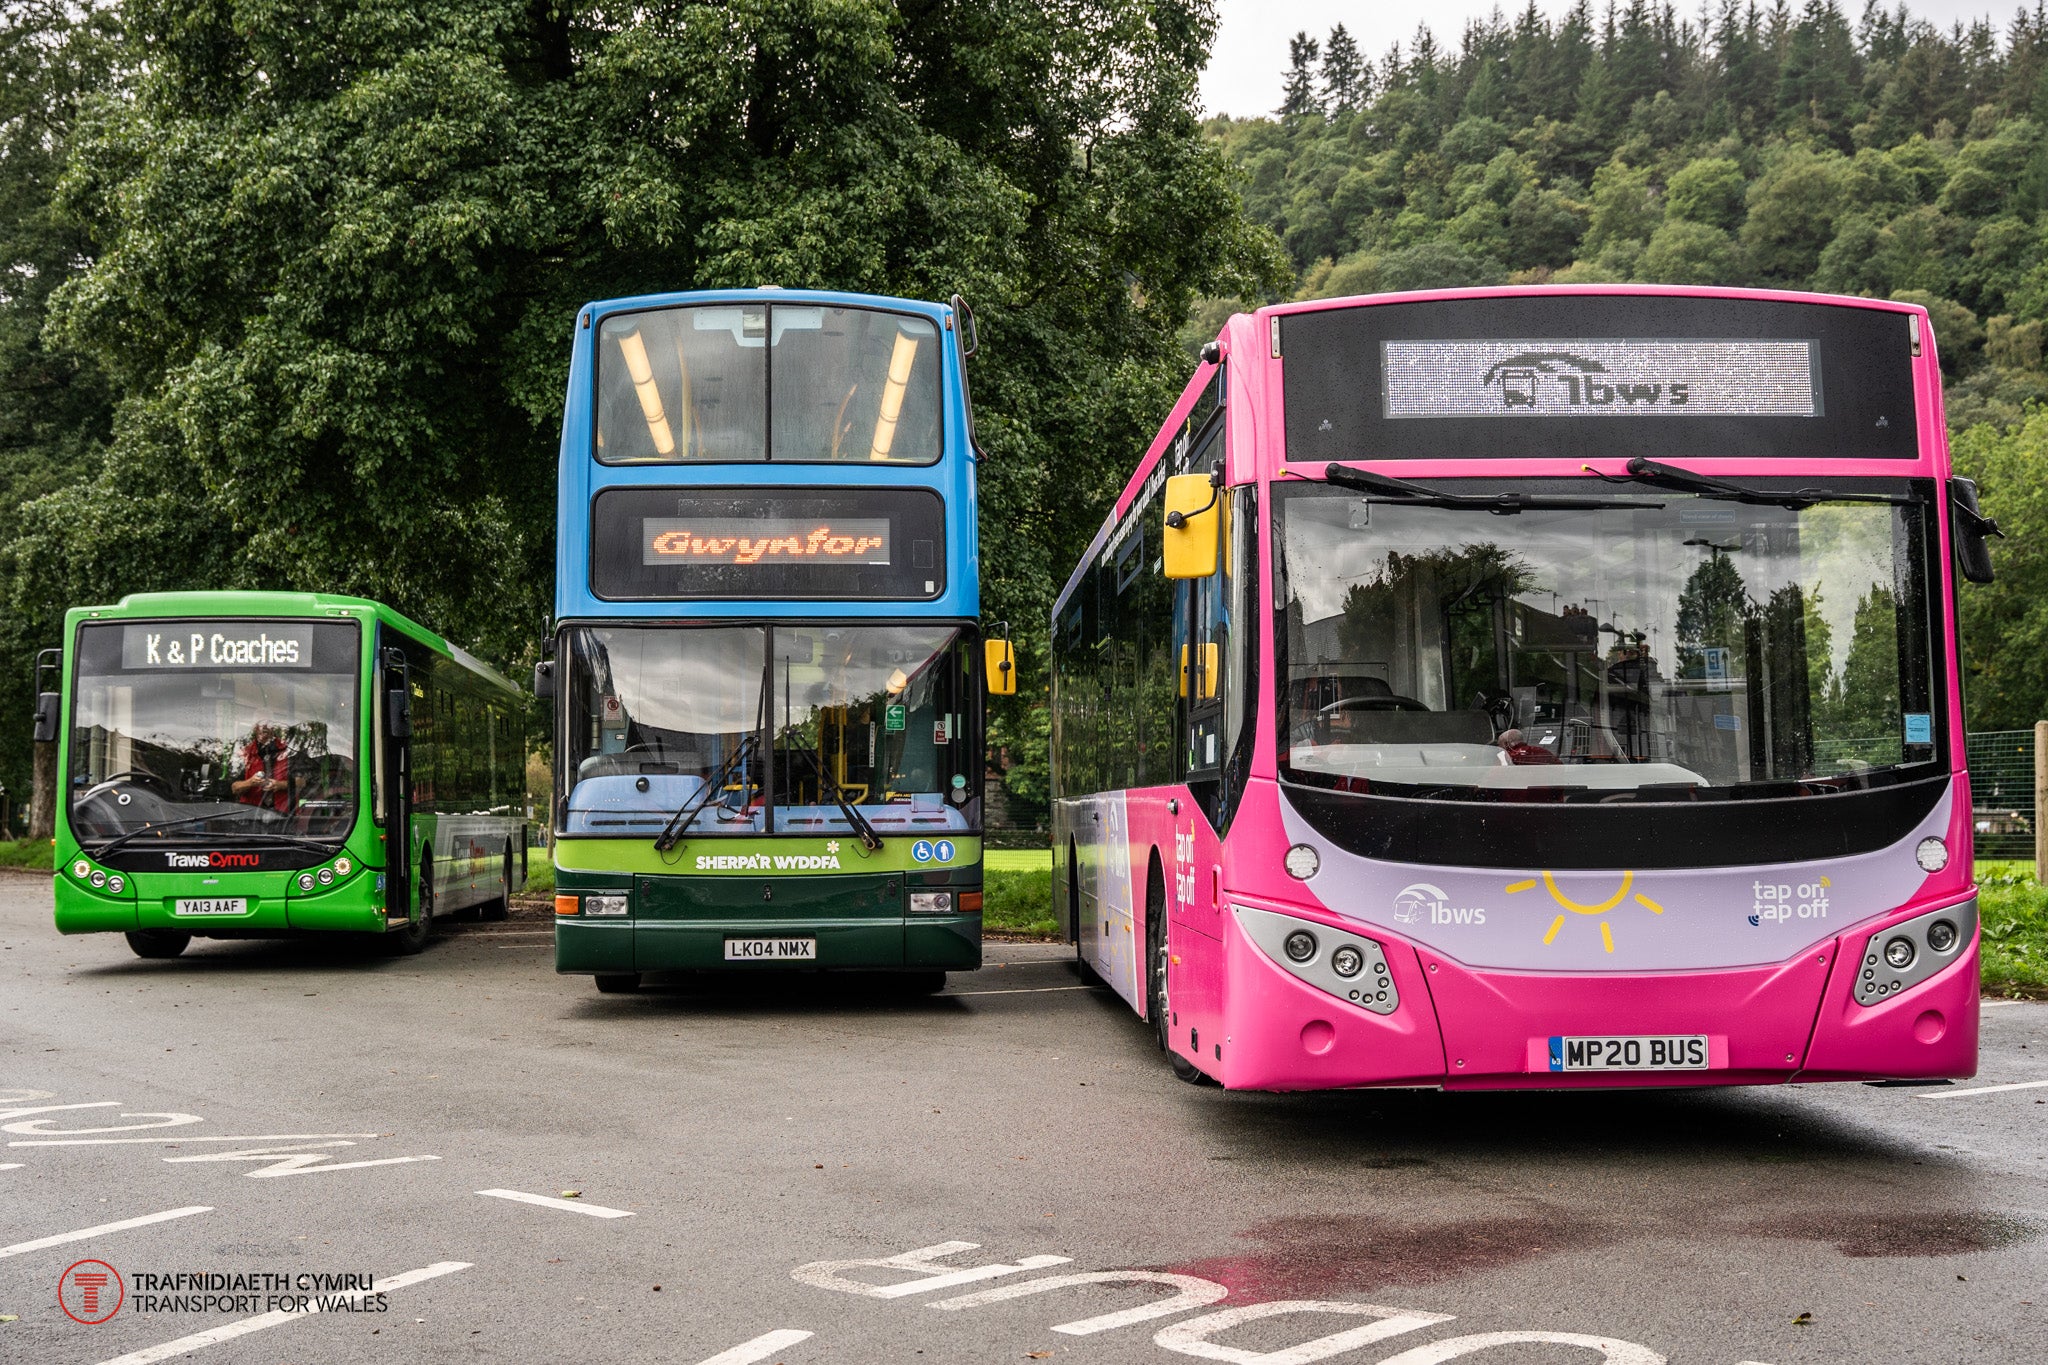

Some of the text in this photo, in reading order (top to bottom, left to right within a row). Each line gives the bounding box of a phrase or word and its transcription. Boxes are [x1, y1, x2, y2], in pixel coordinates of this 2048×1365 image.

[1556, 375, 1689, 405] 1bws
[653, 528, 882, 563] Gwynfor
[147, 633, 299, 664] K & P Coaches
[165, 852, 259, 868] TrawsCymru
[1175, 824, 1185, 872] tap
[696, 853, 841, 870] SHERPA'R WYDDFA
[1176, 864, 1195, 912] tap off
[1753, 881, 1825, 904] tap on
[184, 900, 239, 913] YA13 AAF
[1426, 900, 1486, 925] 1bws
[1753, 899, 1829, 924] tap off
[732, 941, 810, 957] LK04 NMX
[1567, 1039, 1704, 1067] MP20 BUS
